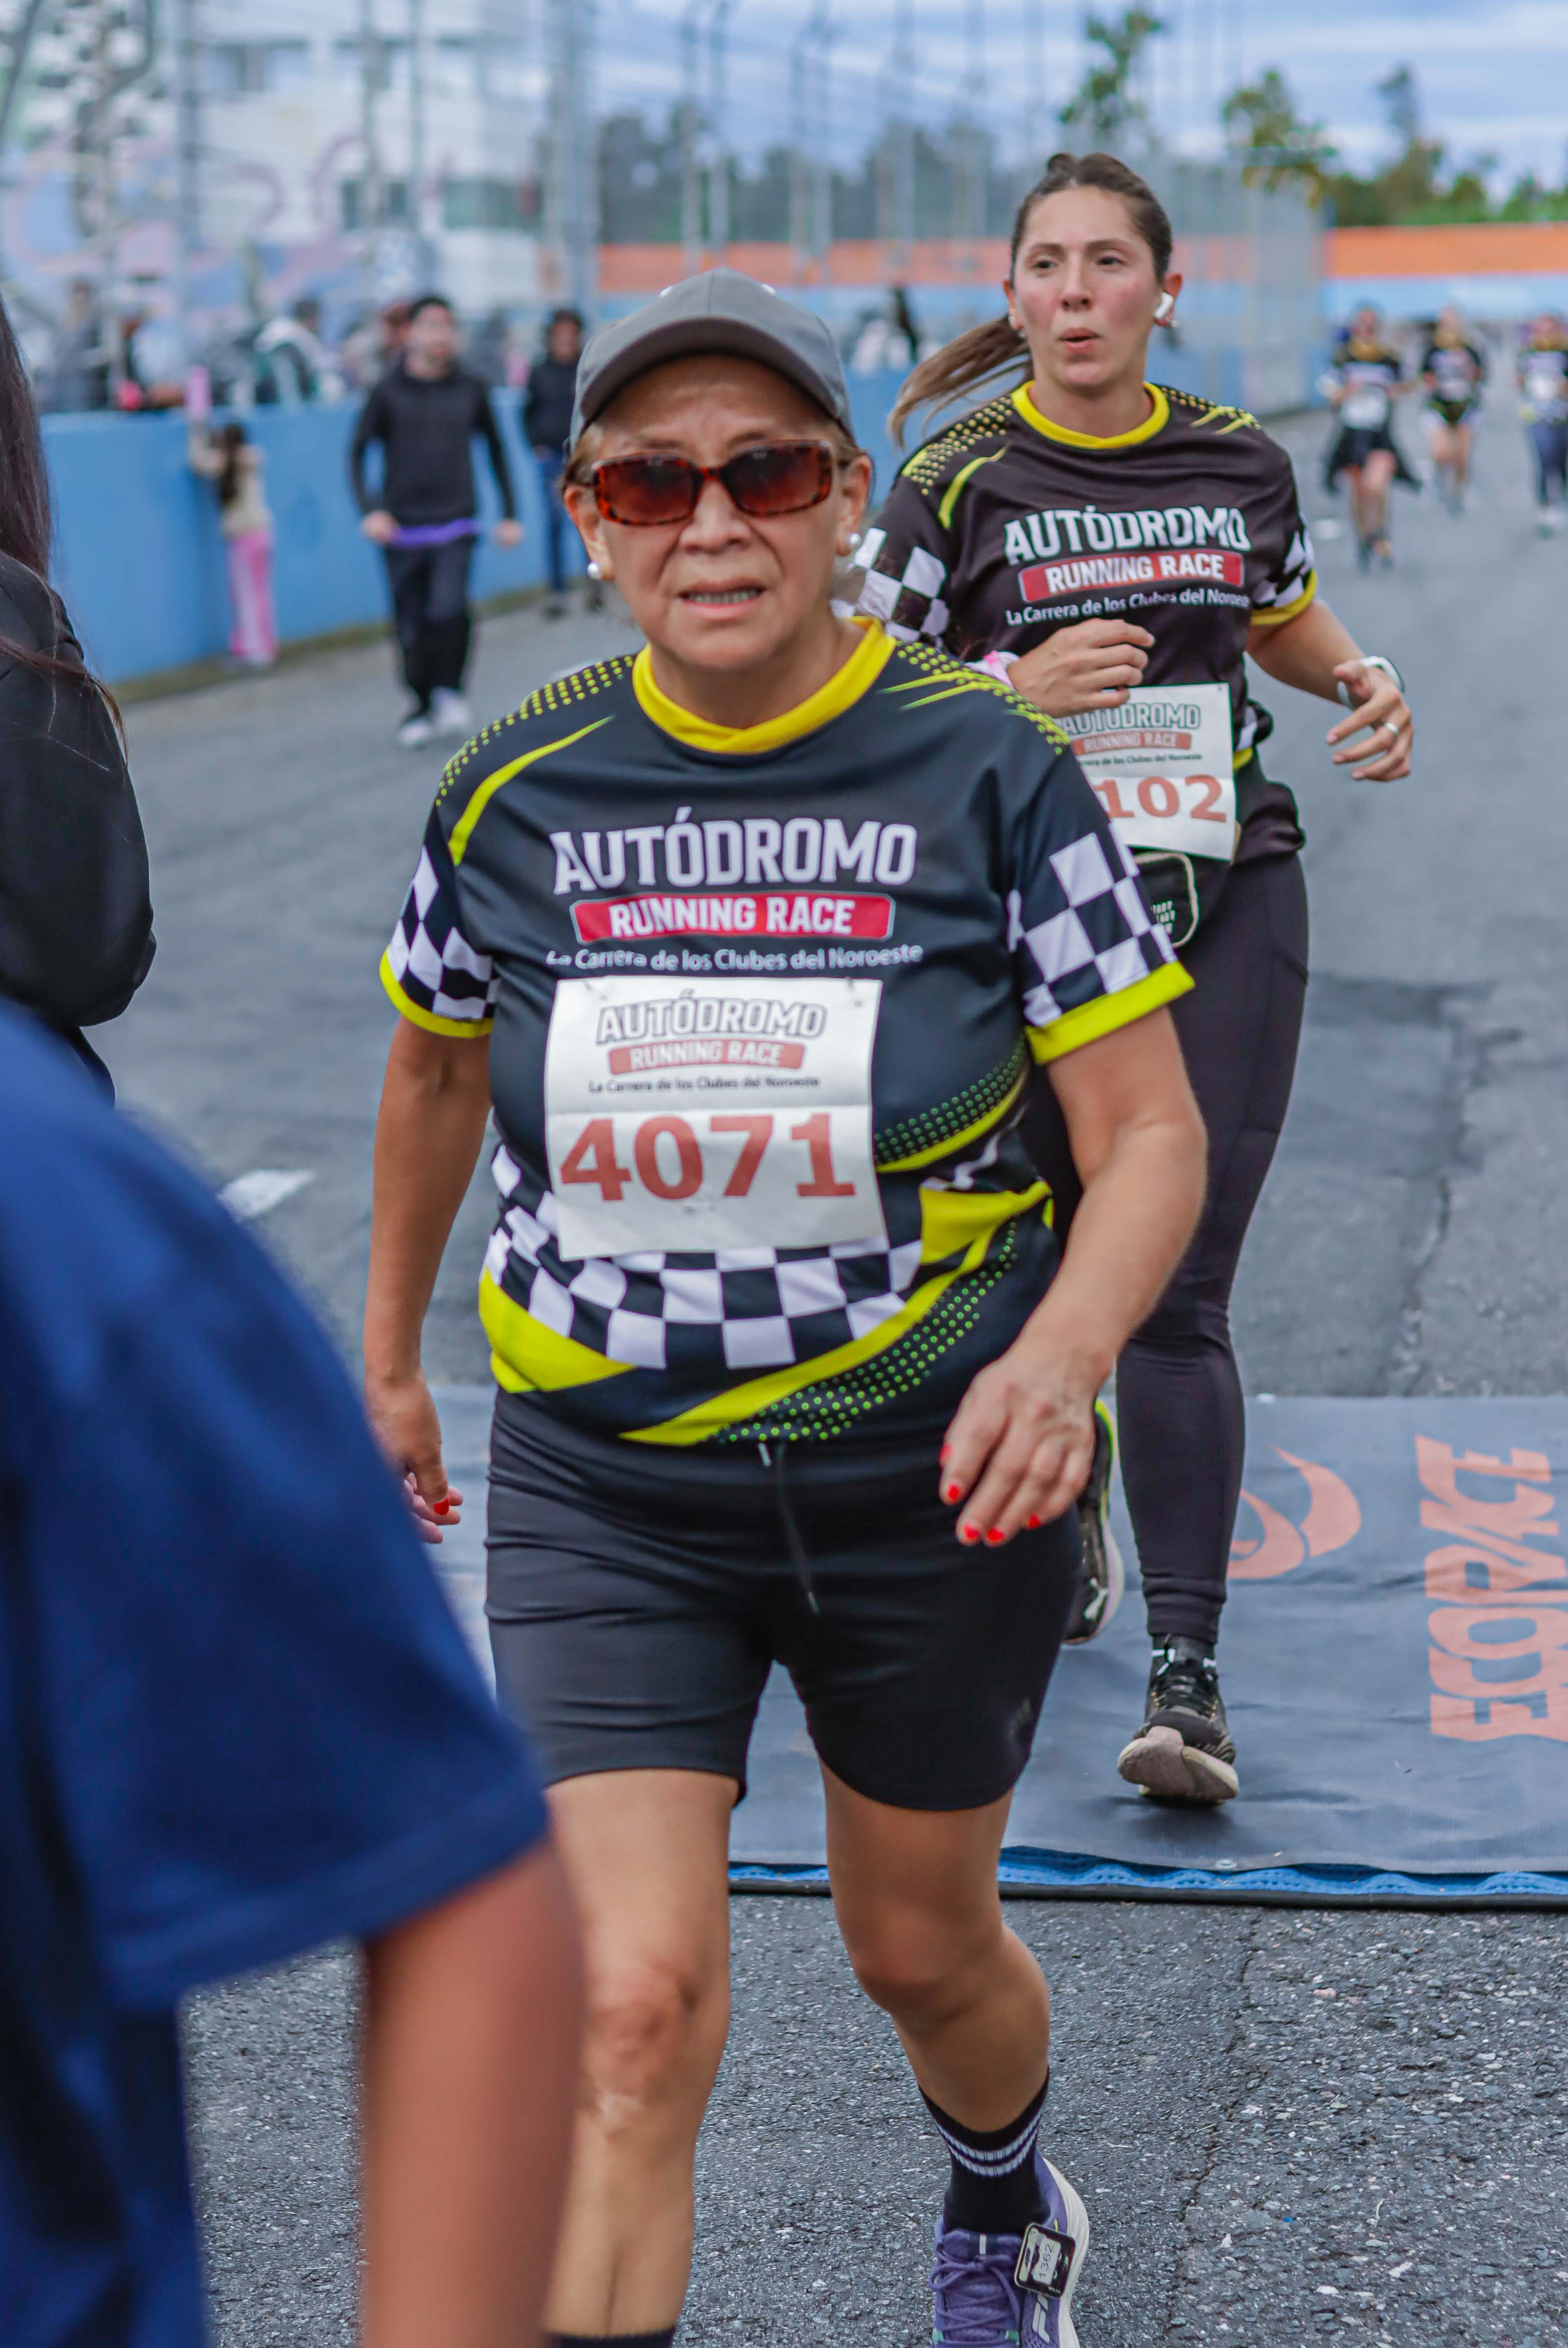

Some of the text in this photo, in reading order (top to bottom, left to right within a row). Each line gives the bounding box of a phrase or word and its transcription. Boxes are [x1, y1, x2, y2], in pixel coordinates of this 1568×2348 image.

[1004, 504, 1252, 565] AUTÓDROMO
[1044, 553, 1225, 595] RUNNING RACE
[1006, 610, 1023, 626] La
[1023, 604, 1079, 624] Carrera
[1081, 599, 1102, 615] de
[1104, 597, 1126, 613] los
[1179, 588, 1205, 605] del
[1084, 732, 1176, 753] RUNNING RACE
[1095, 774, 1227, 823] 102
[550, 806, 917, 895] AUTÓDROMO
[609, 896, 856, 937] RUNNING RACE
[546, 944, 923, 971] La Carrera de los Clubes del Noroeste
[595, 988, 828, 1046] AUTÓDROMO
[629, 1040, 785, 1071] RUNNING RACE
[588, 1079, 603, 1093] La
[607, 1079, 652, 1092] Carrera
[657, 1078, 672, 1090] de
[674, 1076, 693, 1089] los
[742, 1074, 761, 1087] del
[560, 1113, 857, 1202] 4071
[1039, 2243, 1054, 2279] 1362
